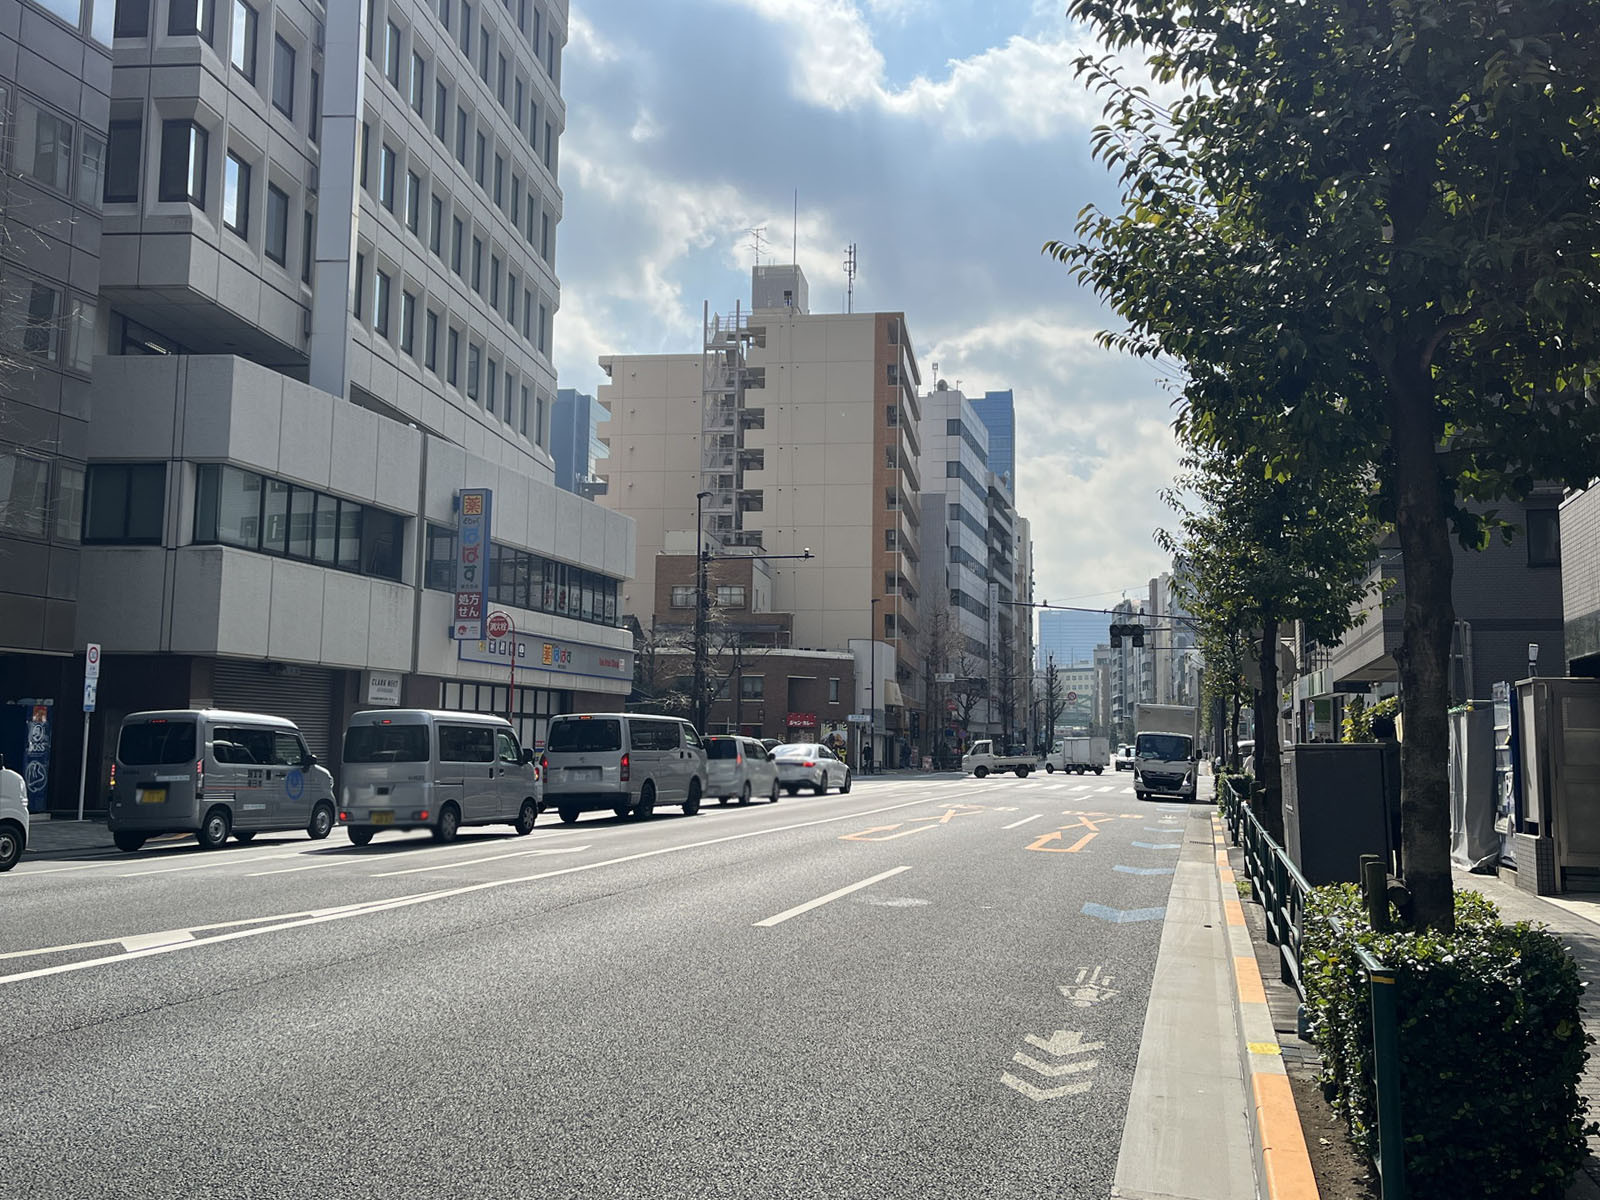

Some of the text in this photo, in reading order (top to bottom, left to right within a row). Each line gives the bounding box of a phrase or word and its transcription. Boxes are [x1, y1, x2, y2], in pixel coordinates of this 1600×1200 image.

[464, 496, 481, 514] 薬
[458, 594, 480, 606] 処方
[458, 606, 479, 617] せん
